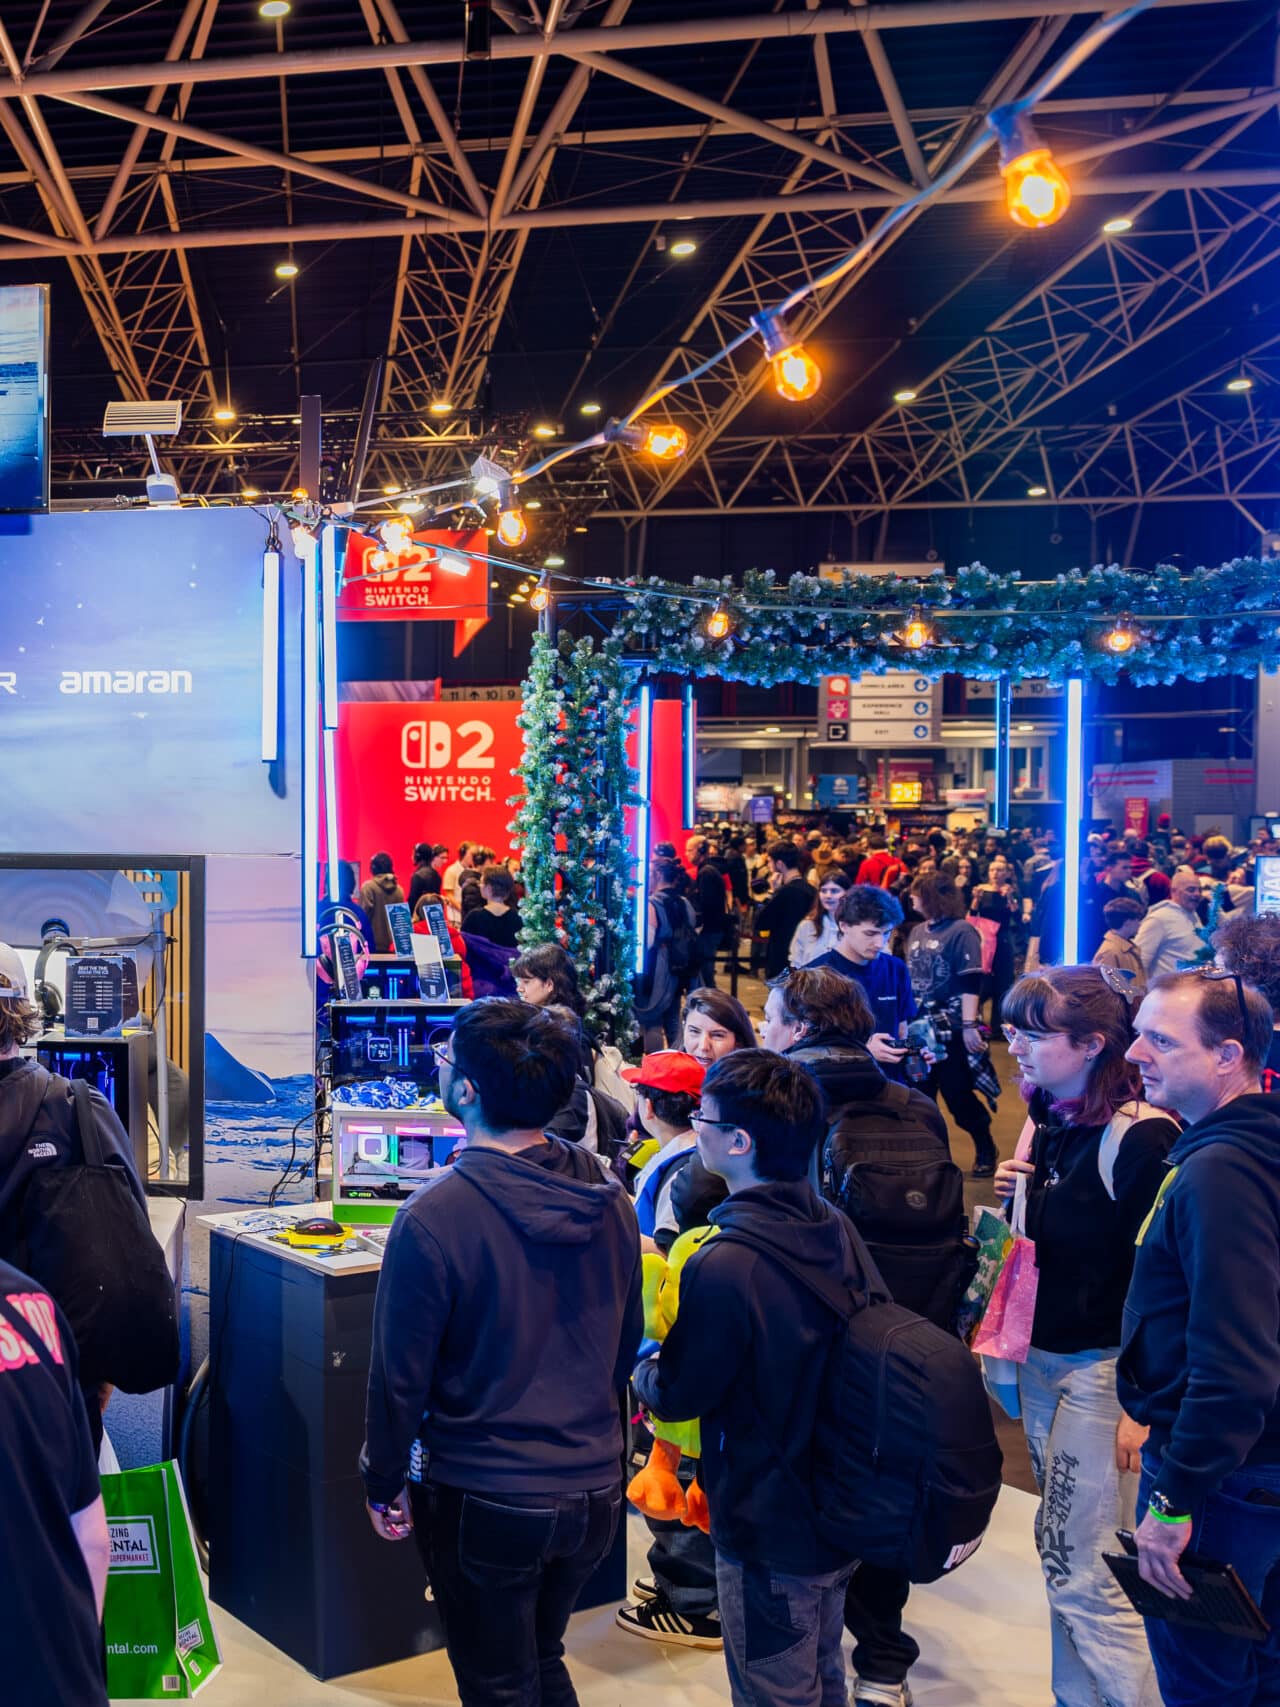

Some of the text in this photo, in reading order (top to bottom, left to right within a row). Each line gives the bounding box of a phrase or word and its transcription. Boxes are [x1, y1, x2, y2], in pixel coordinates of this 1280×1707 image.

[365, 586, 429, 594] NINTENDO
[365, 594, 429, 606] SWITCH
[59, 671, 192, 694] amaran
[451, 690, 515, 700] 11 10 9
[456, 720, 495, 768] 2
[405, 776, 491, 784] NINTENDO
[404, 786, 490, 801] SWITCH
[110, 1528, 129, 1538] ZING
[107, 1642, 158, 1654] ntal.com
